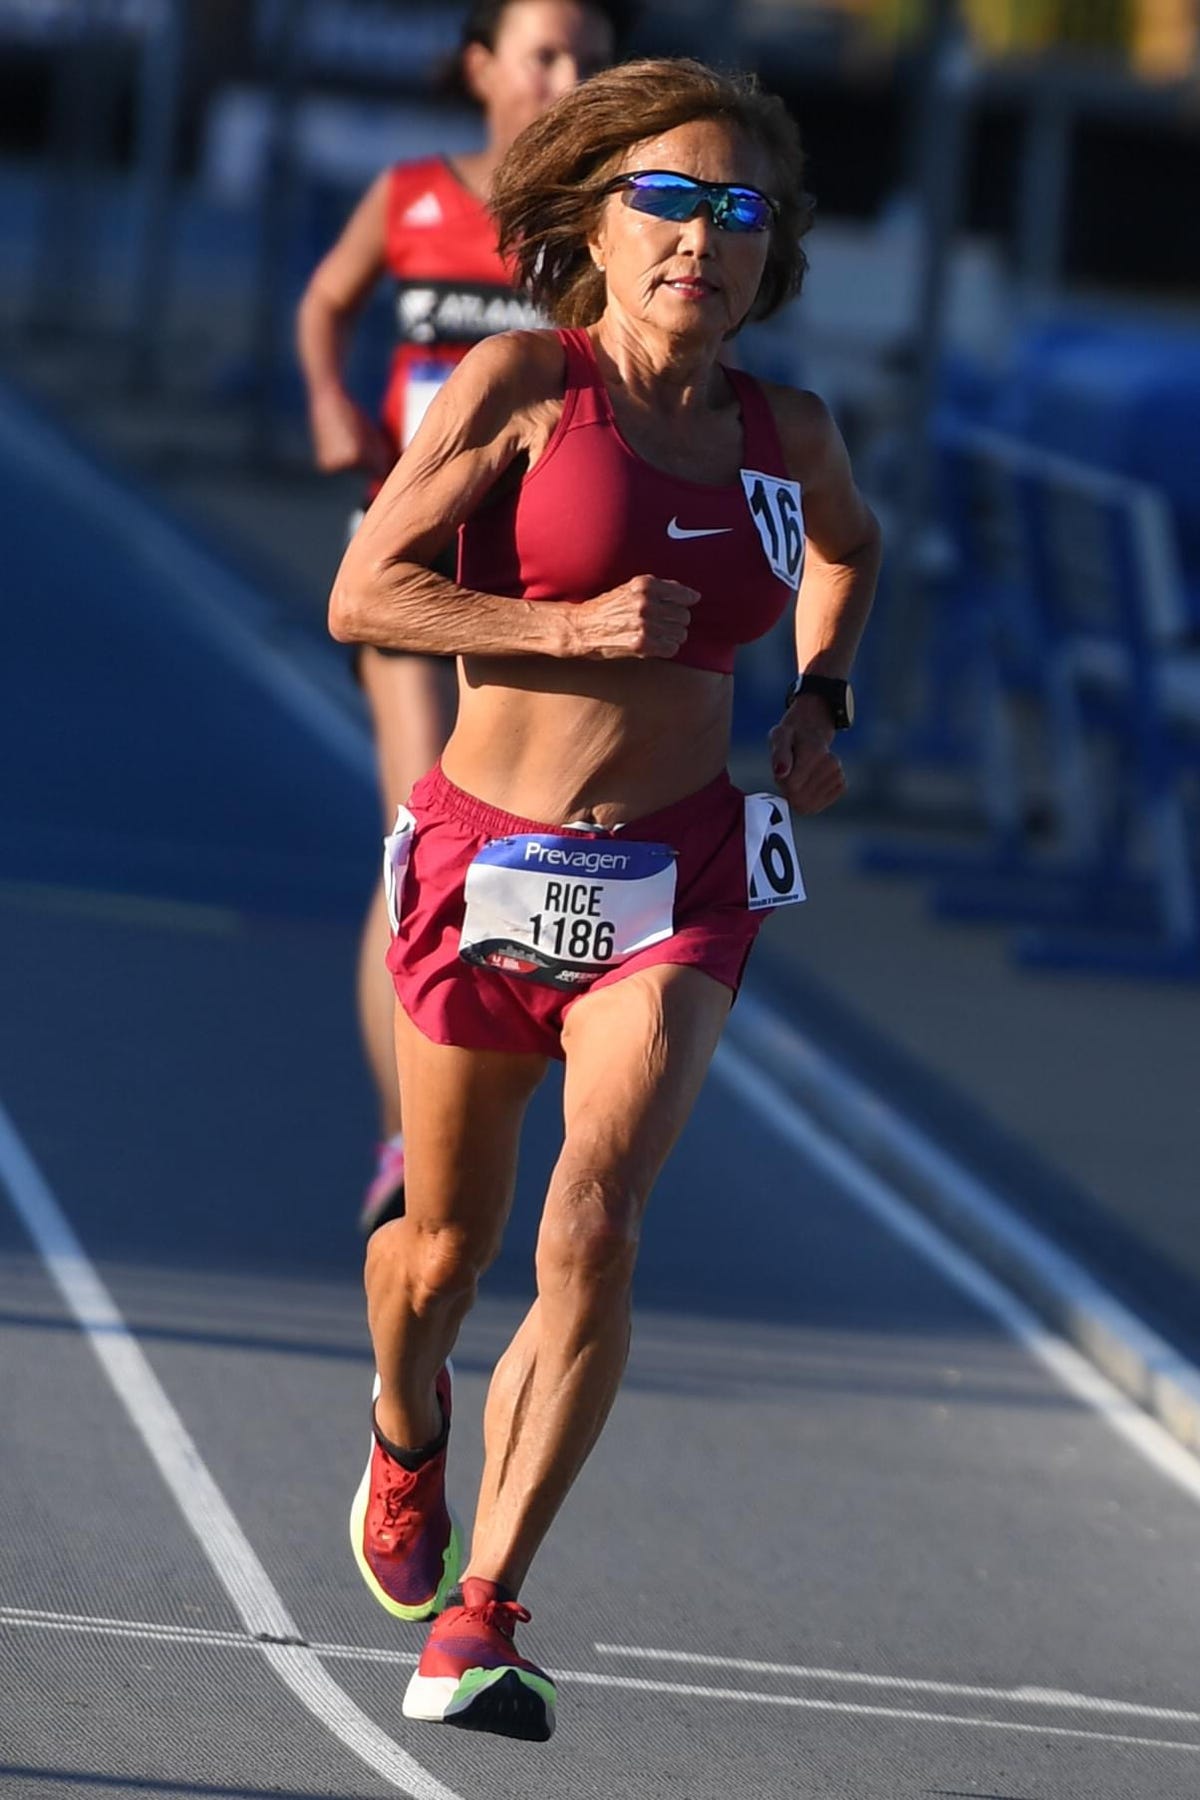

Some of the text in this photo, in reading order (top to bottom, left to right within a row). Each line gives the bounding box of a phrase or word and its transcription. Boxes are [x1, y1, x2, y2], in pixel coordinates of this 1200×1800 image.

[750, 479, 802, 576] 16
[524, 841, 628, 873] Prevagen
[544, 881, 604, 917] RICE
[529, 913, 616, 961] 1186
